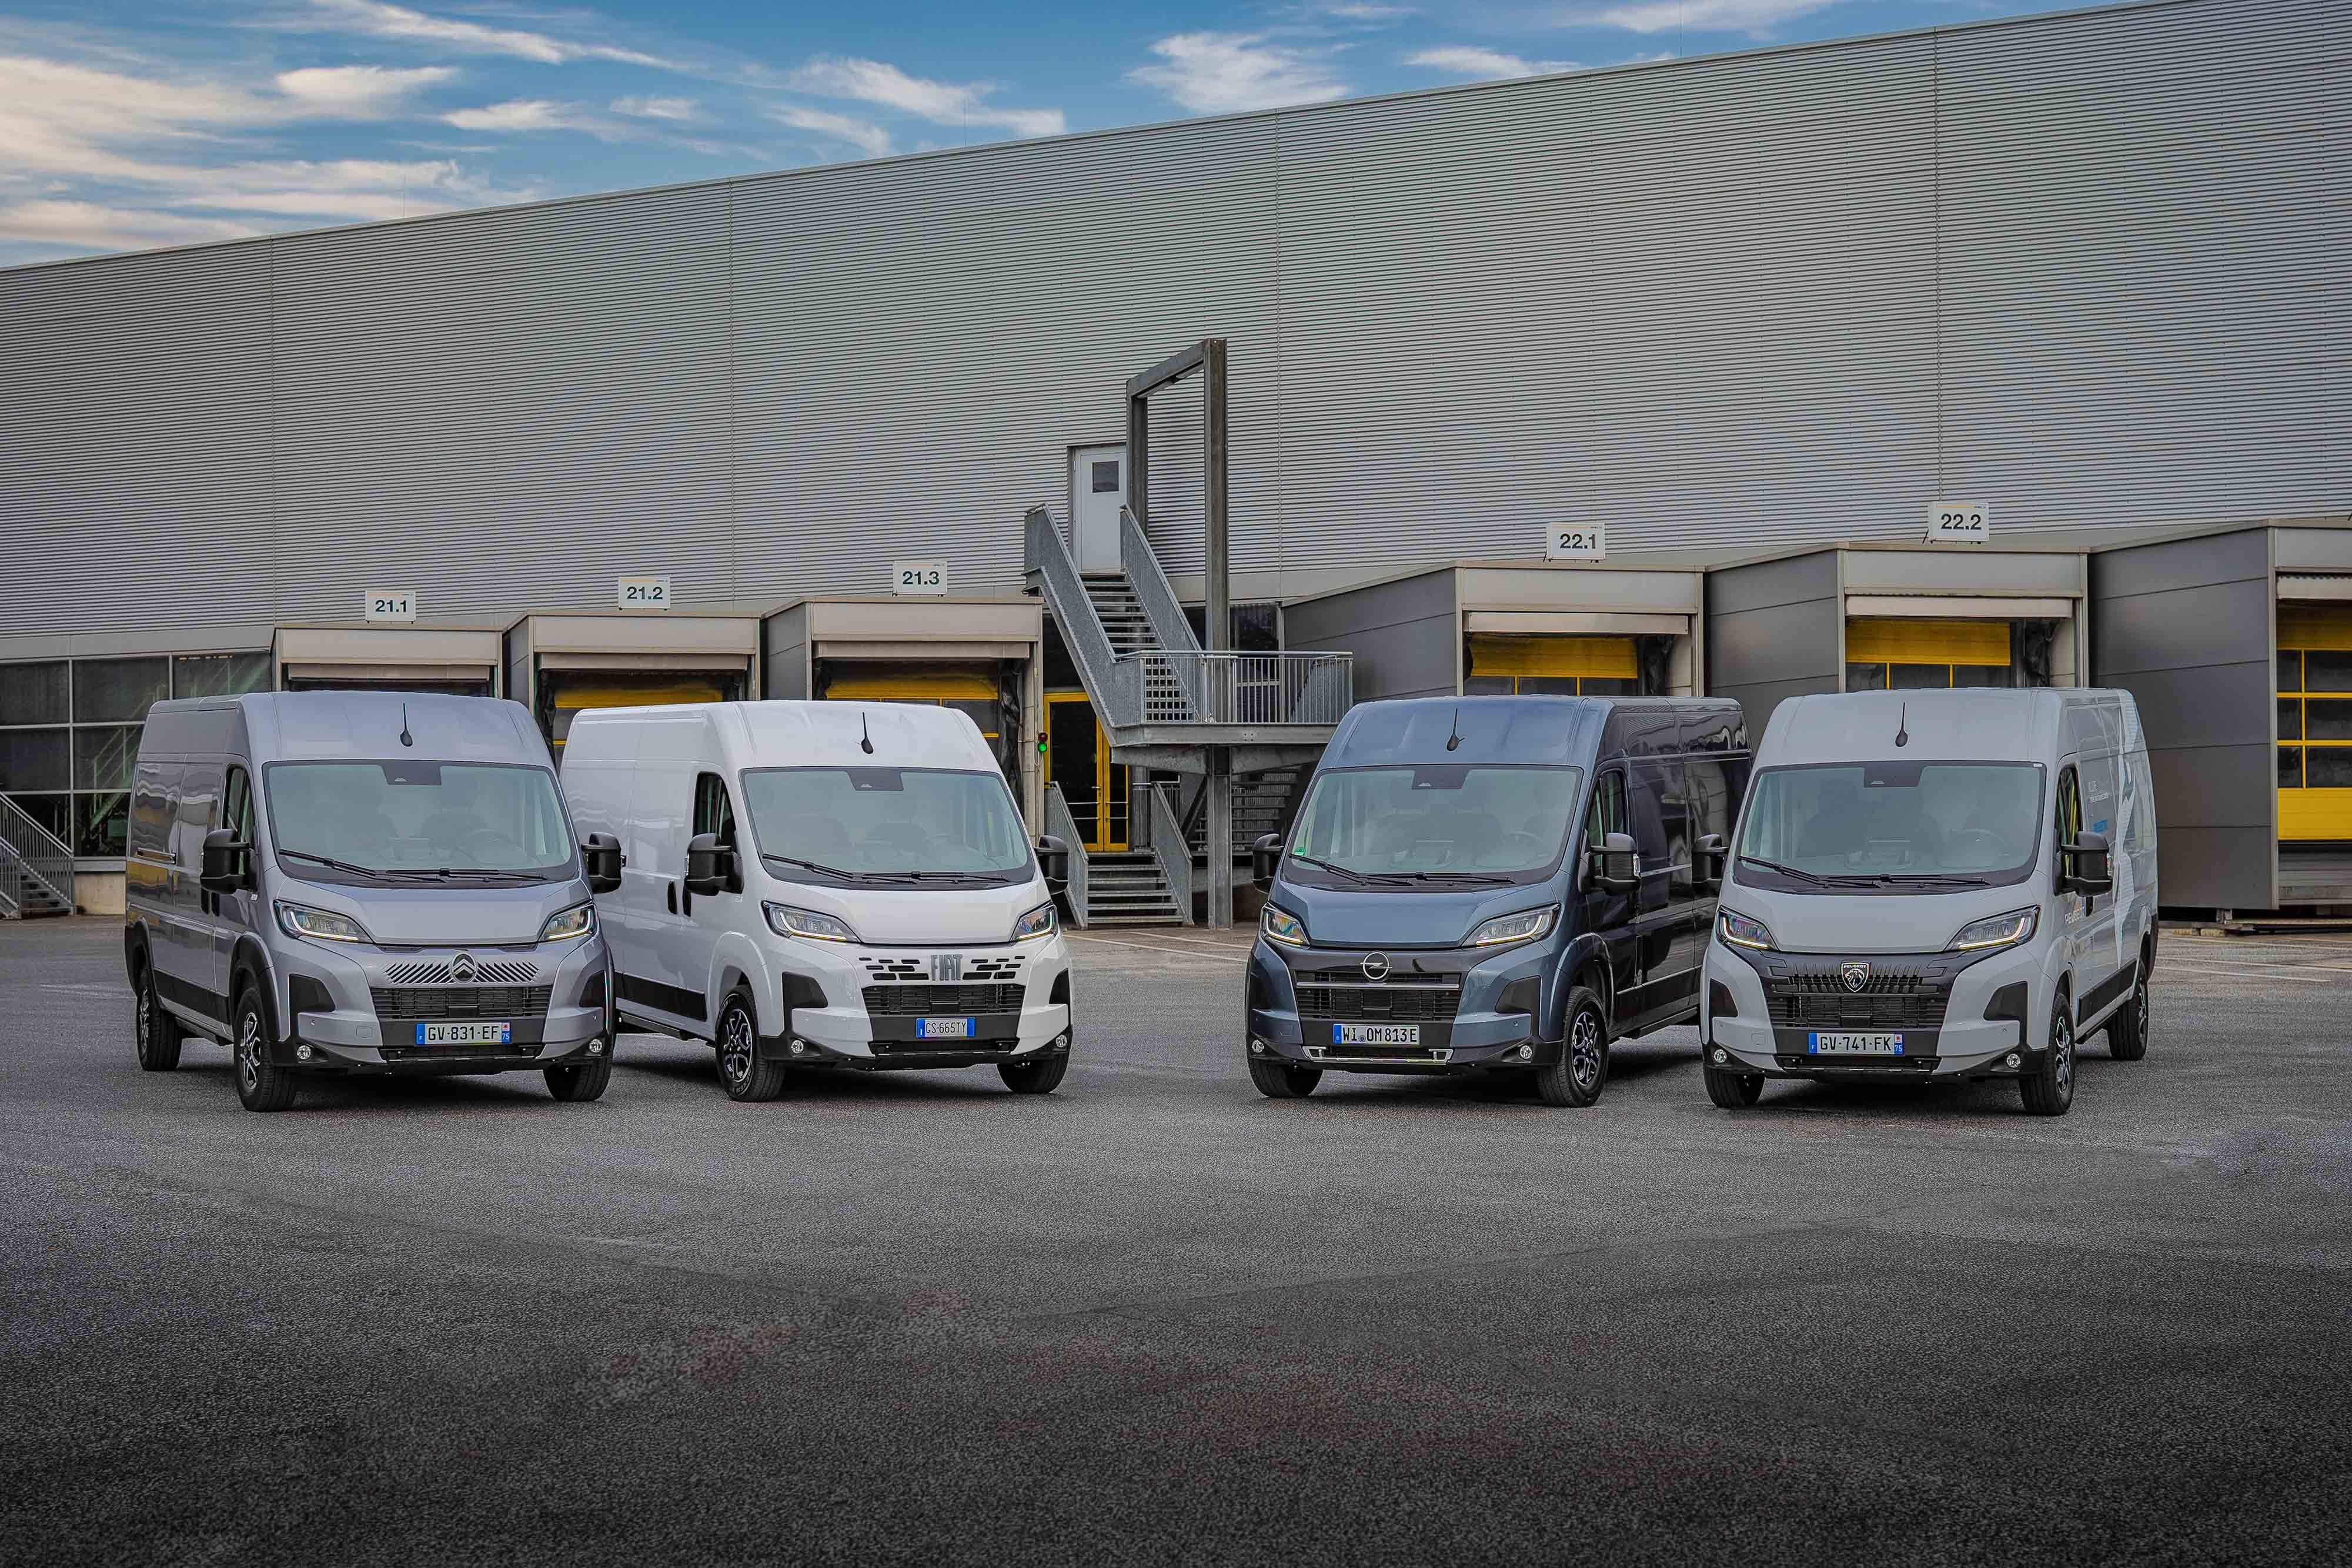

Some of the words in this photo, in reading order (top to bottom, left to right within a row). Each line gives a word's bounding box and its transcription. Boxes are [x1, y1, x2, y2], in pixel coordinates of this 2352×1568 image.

[1941, 513, 1982, 530] 22.2
[1559, 533, 1596, 549] 22.1
[903, 571, 940, 585] 21.3
[626, 586, 663, 600] 21.2
[375, 600, 406, 612] 21.1
[930, 954, 963, 981] FIAT
[427, 1025, 499, 1041] GV-831-EF
[1820, 1037, 1892, 1051] GV-741-FK
